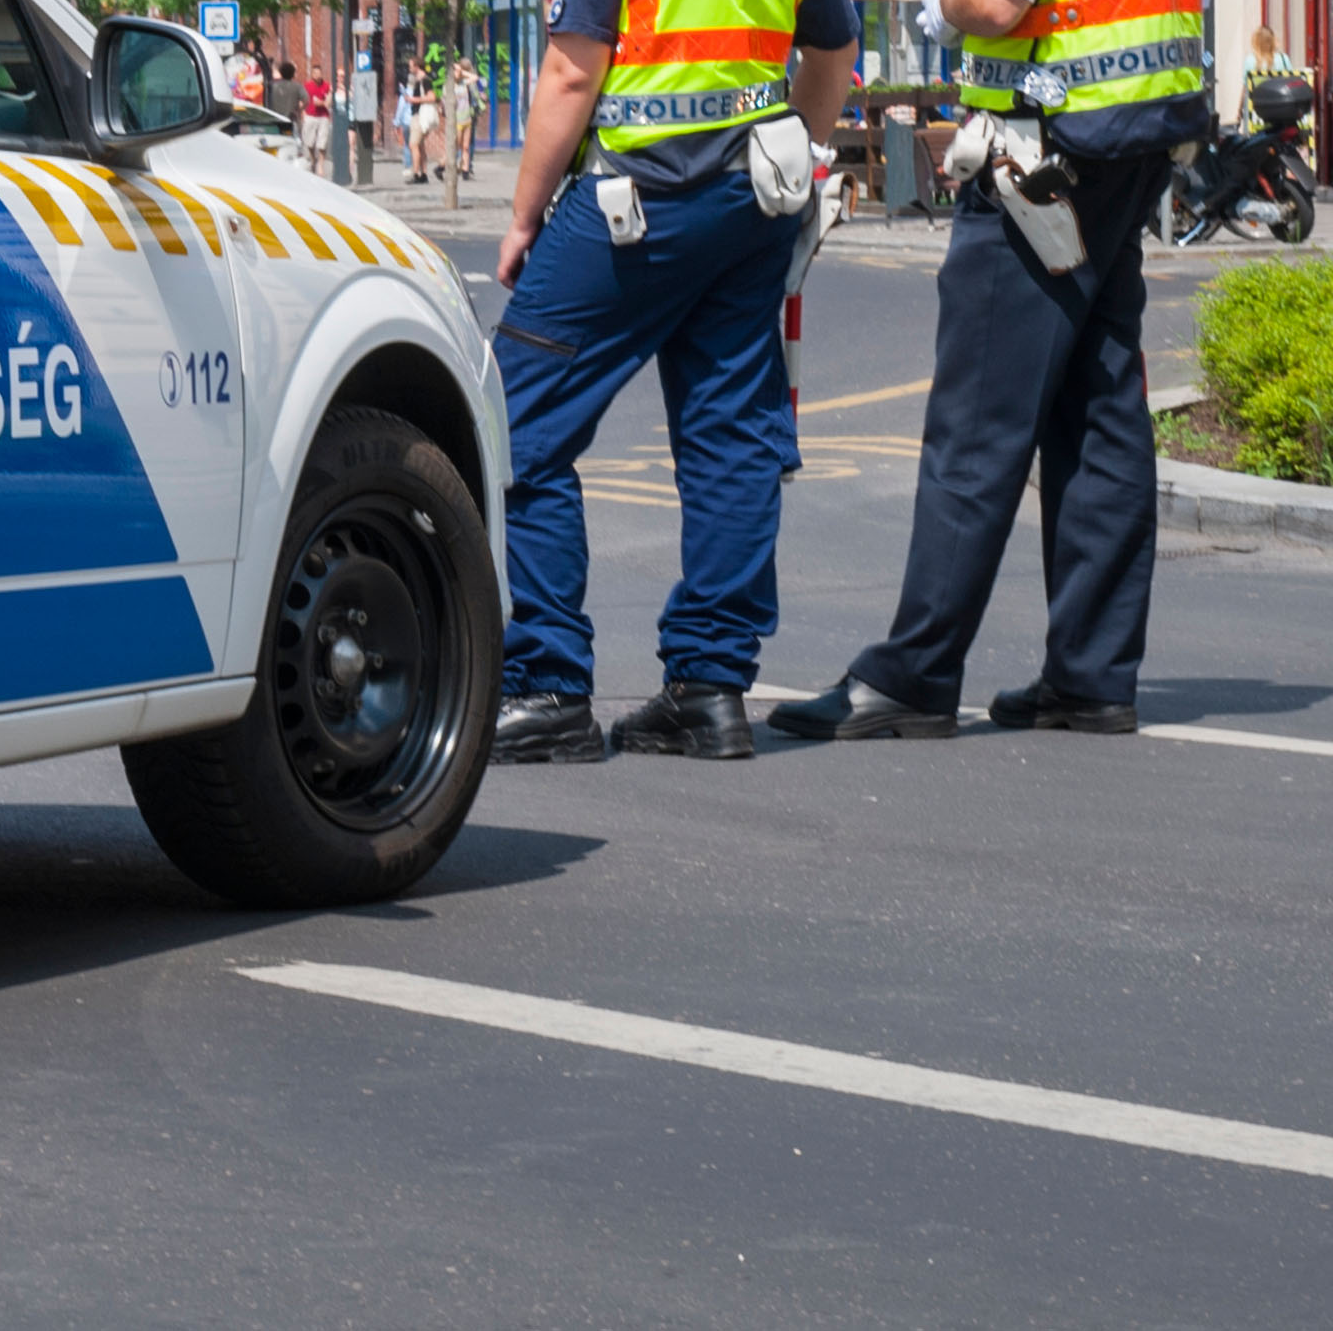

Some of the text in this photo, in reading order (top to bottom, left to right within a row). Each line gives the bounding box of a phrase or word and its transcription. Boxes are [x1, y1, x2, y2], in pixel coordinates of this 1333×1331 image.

[974, 59, 1031, 85] POLIC
[624, 95, 733, 121] POLICE
[185, 351, 230, 404] 112
